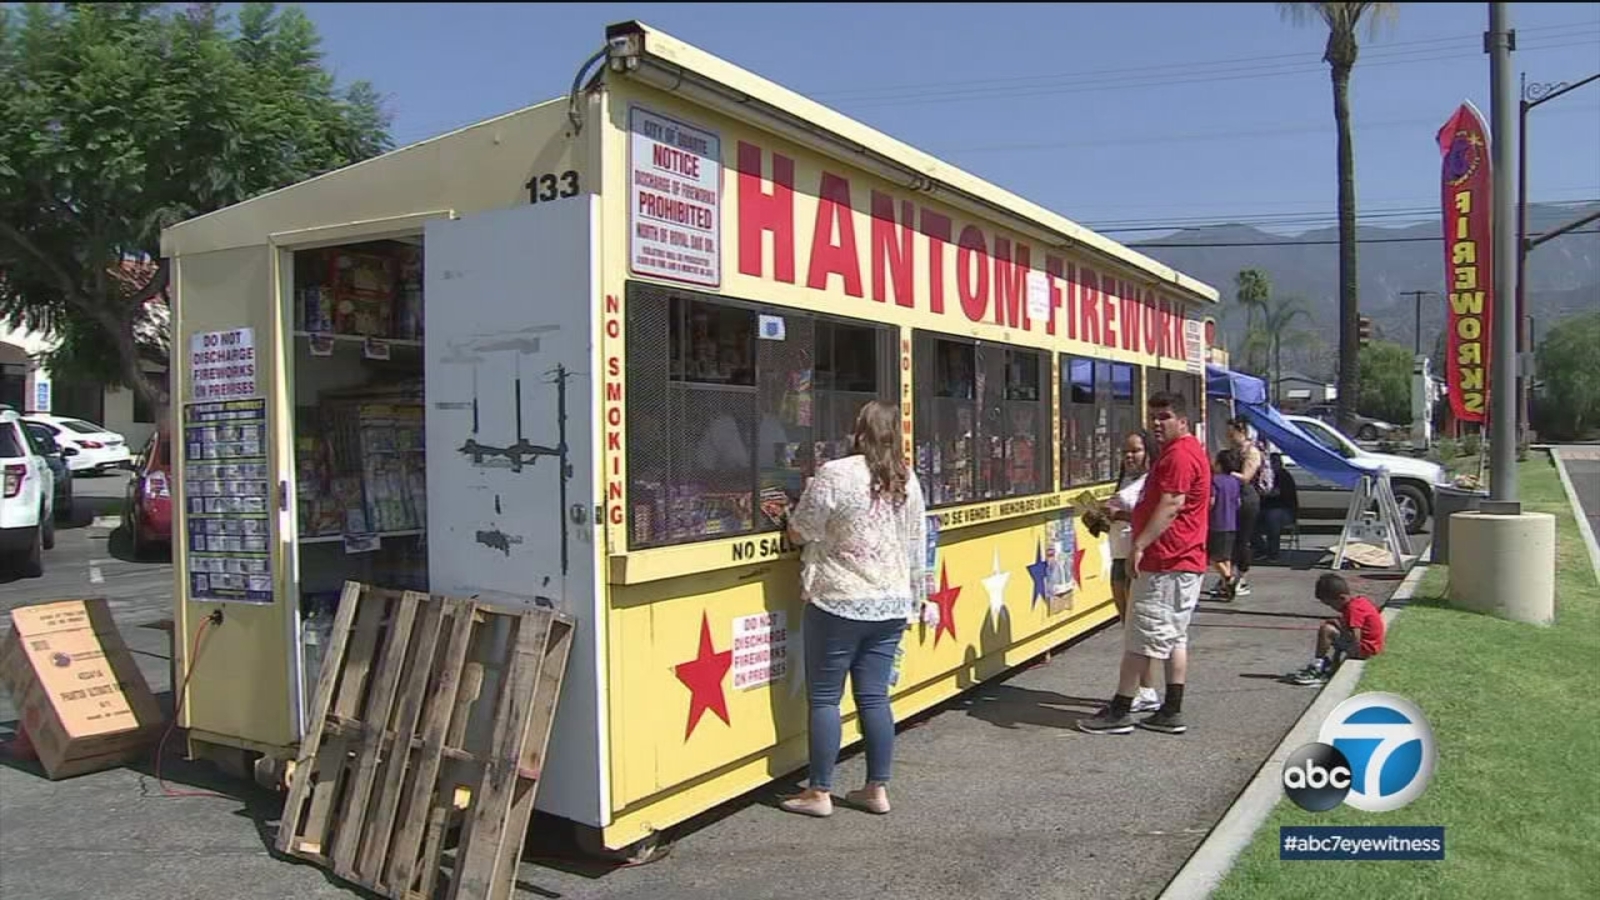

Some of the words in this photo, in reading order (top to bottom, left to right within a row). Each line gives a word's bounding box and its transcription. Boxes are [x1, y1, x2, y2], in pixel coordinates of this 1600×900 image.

[644, 120, 662, 140] CITY
[653, 143, 700, 178] NOTICE
[525, 170, 579, 204] 133
[635, 170, 670, 192] DISCHARGE
[672, 180, 681, 196] OF
[639, 191, 712, 229] PROHIBITED
[720, 139, 1031, 331] HANTOM
[605, 294, 619, 339] NO
[204, 334, 219, 347] DO
[221, 331, 241, 346] NOT
[194, 347, 254, 365] DISCHARGE
[902, 339, 911, 371] NO
[194, 364, 254, 381] FIREWORKS
[209, 381, 254, 396] PREMISES
[607, 356, 623, 525] SMOKING
[732, 541, 756, 561] NO
[759, 535, 791, 558] SAL
[744, 618, 757, 631] DO
[760, 613, 777, 627] NOT
[735, 629, 786, 650] DISCHARGE
[735, 646, 786, 669] FIREWORKS
[735, 673, 746, 686] ON
[749, 661, 786, 682] PREMISES
